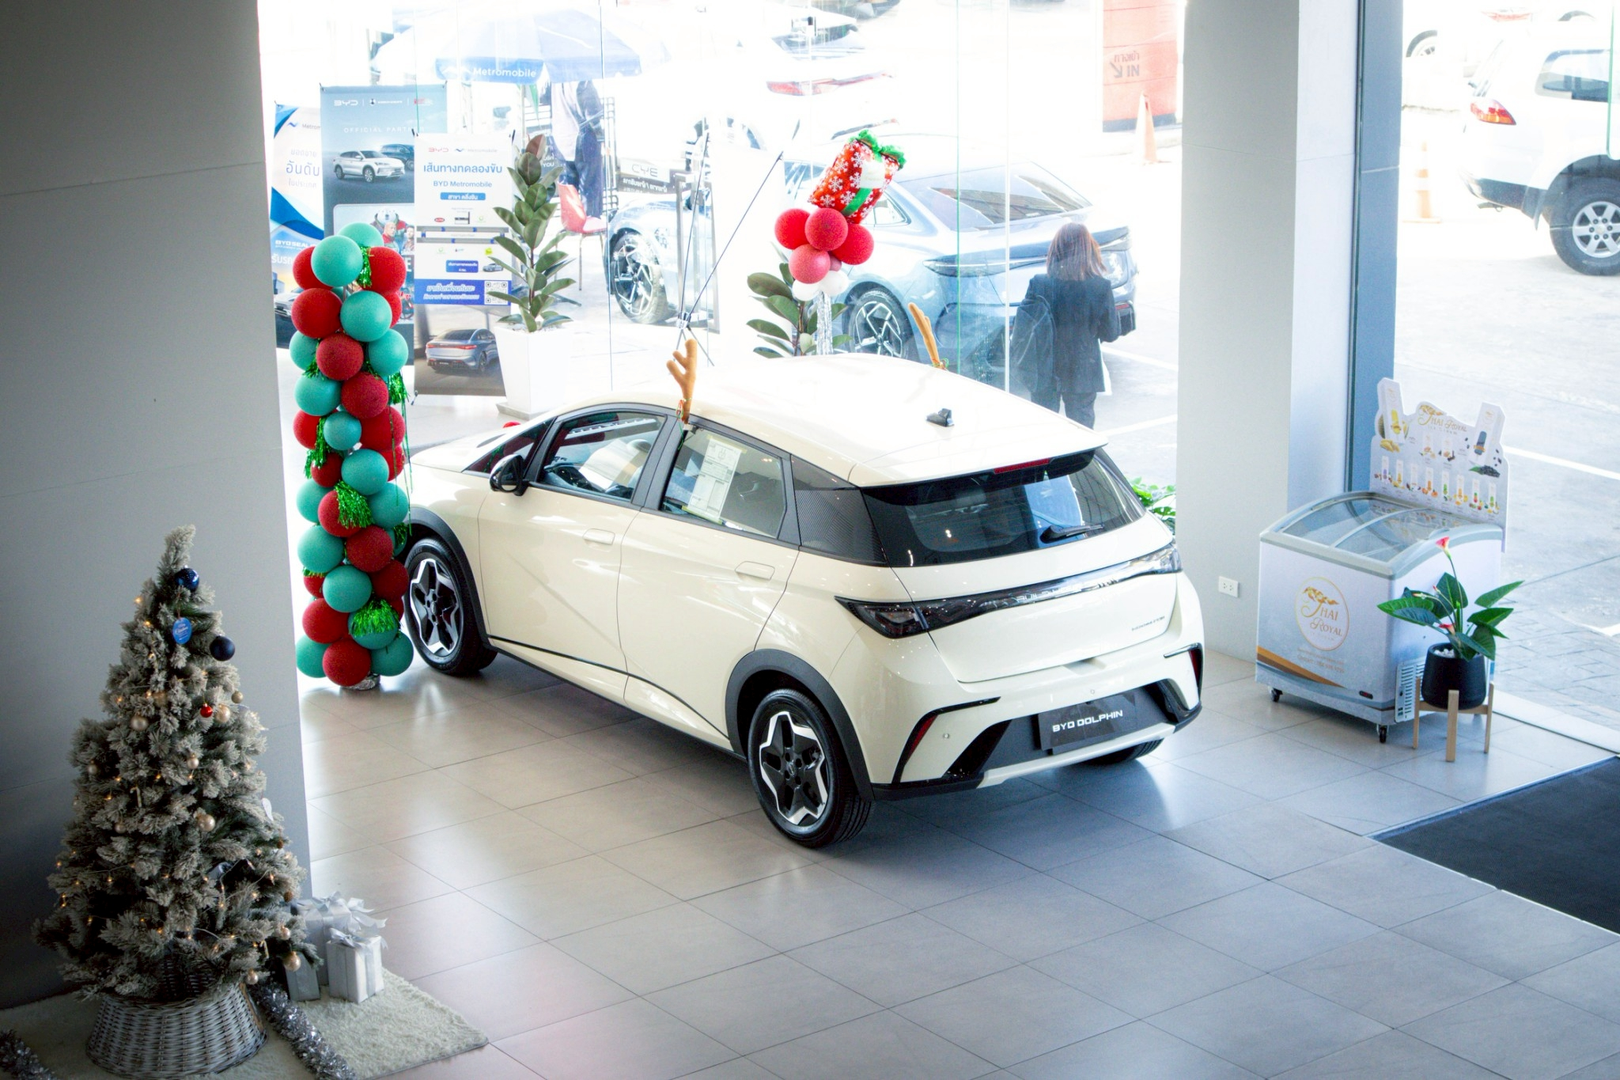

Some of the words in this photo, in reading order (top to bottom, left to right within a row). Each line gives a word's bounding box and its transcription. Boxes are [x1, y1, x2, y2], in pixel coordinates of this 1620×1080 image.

[473, 67, 537, 79] Metromobile
[1127, 64, 1140, 77] IN
[333, 99, 359, 107] BYD
[343, 126, 382, 134] OFFICIAL
[285, 160, 320, 177] อันดับ
[423, 162, 503, 174] เส้นทางทดลองขับ
[433, 180, 449, 188] BYD
[450, 181, 493, 189] Metromobile
[1300, 586, 1340, 621] THAI
[1309, 617, 1343, 637] ROYAL
[1052, 720, 1075, 733] BYD
[1076, 709, 1124, 727] DOLPHIN
